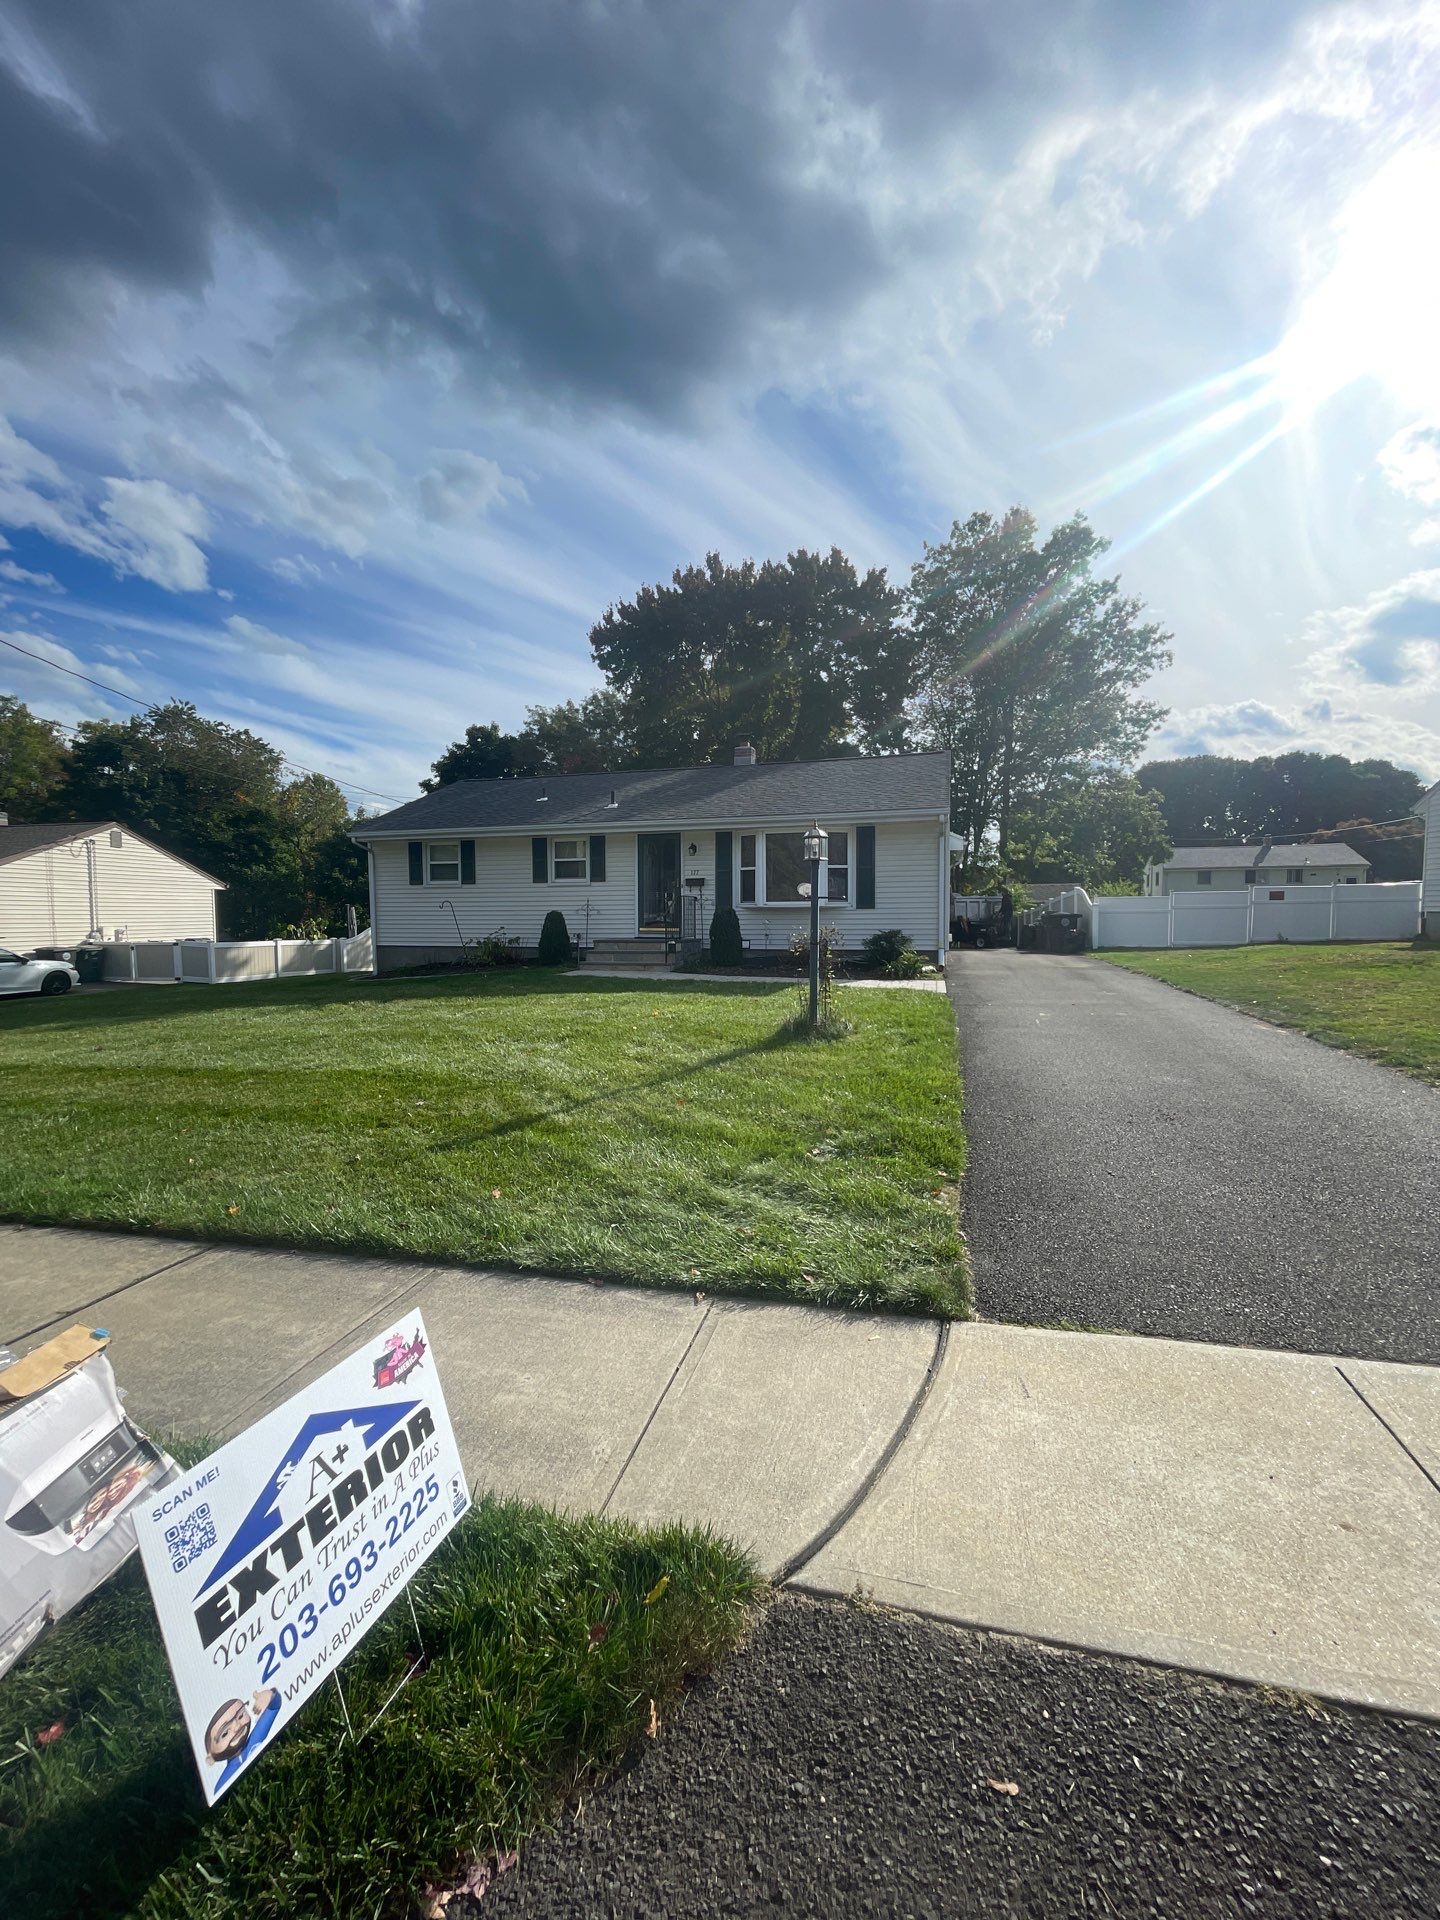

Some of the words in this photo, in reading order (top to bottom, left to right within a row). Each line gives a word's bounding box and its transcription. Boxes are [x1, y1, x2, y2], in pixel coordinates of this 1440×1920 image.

[152, 1486, 193, 1522] SCAN
[195, 1466, 220, 1491] ME!
[193, 1406, 436, 1650] EXTERIOR
[213, 1617, 264, 1670] You
[271, 1569, 314, 1621] Can
[317, 1512, 367, 1572] Trust
[372, 1492, 388, 1520] in
[392, 1471, 406, 1506] A
[408, 1442, 440, 1480] Plus
[305, 1443, 349, 1505] A+
[257, 1473, 439, 1685] 203-693-2225
[284, 1511, 448, 1701] www.aplusexterior.com
